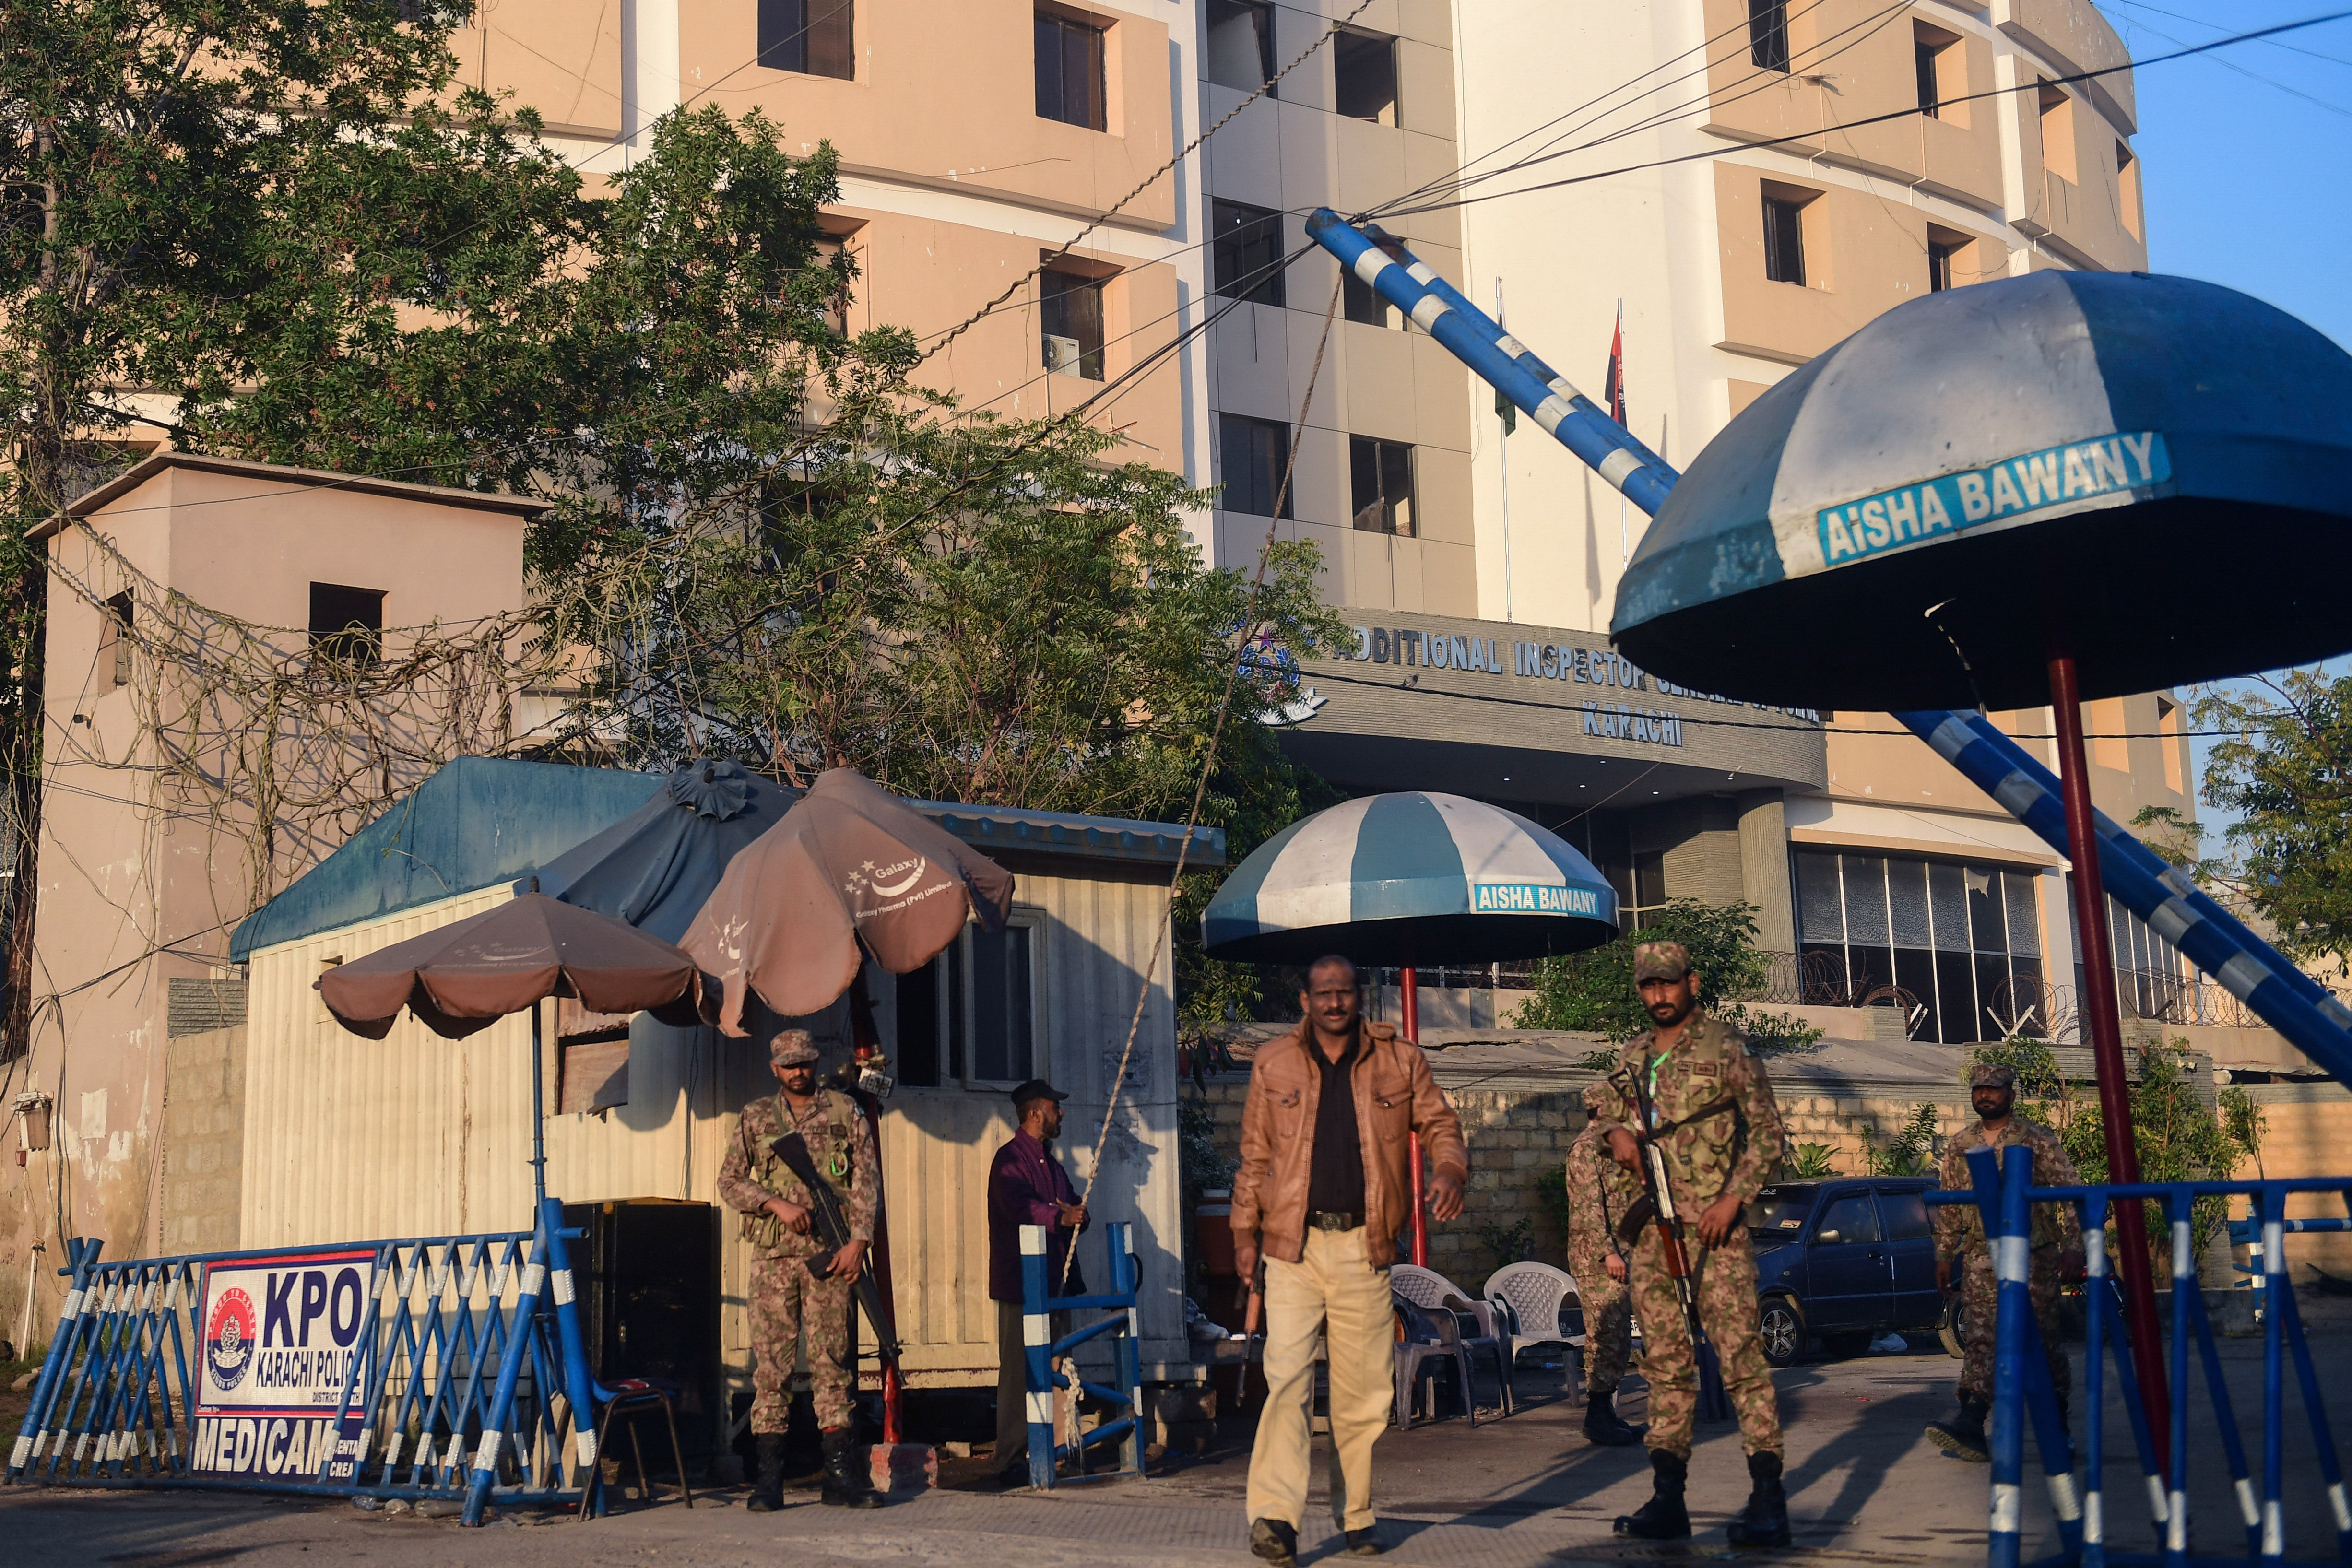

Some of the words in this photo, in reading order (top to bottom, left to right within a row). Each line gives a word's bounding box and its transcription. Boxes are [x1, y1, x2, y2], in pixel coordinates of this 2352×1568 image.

[1957, 432, 2153, 522] BAWANY
[1515, 641, 1647, 691] INSPECTOR
[1583, 700, 1684, 747] KARACHI
[875, 858, 918, 878] Galaxy
[906, 891, 925, 906] (Pvt)
[924, 881, 952, 896] Limited
[1479, 887, 1535, 908] AISHA
[1539, 887, 1596, 914] BAWANY
[263, 1267, 362, 1347] KPO
[256, 1351, 313, 1387] KARACHI
[312, 1392, 338, 1403] DISTRICT
[193, 1418, 334, 1475] MEDICAM
[329, 1461, 354, 1477] CREA
